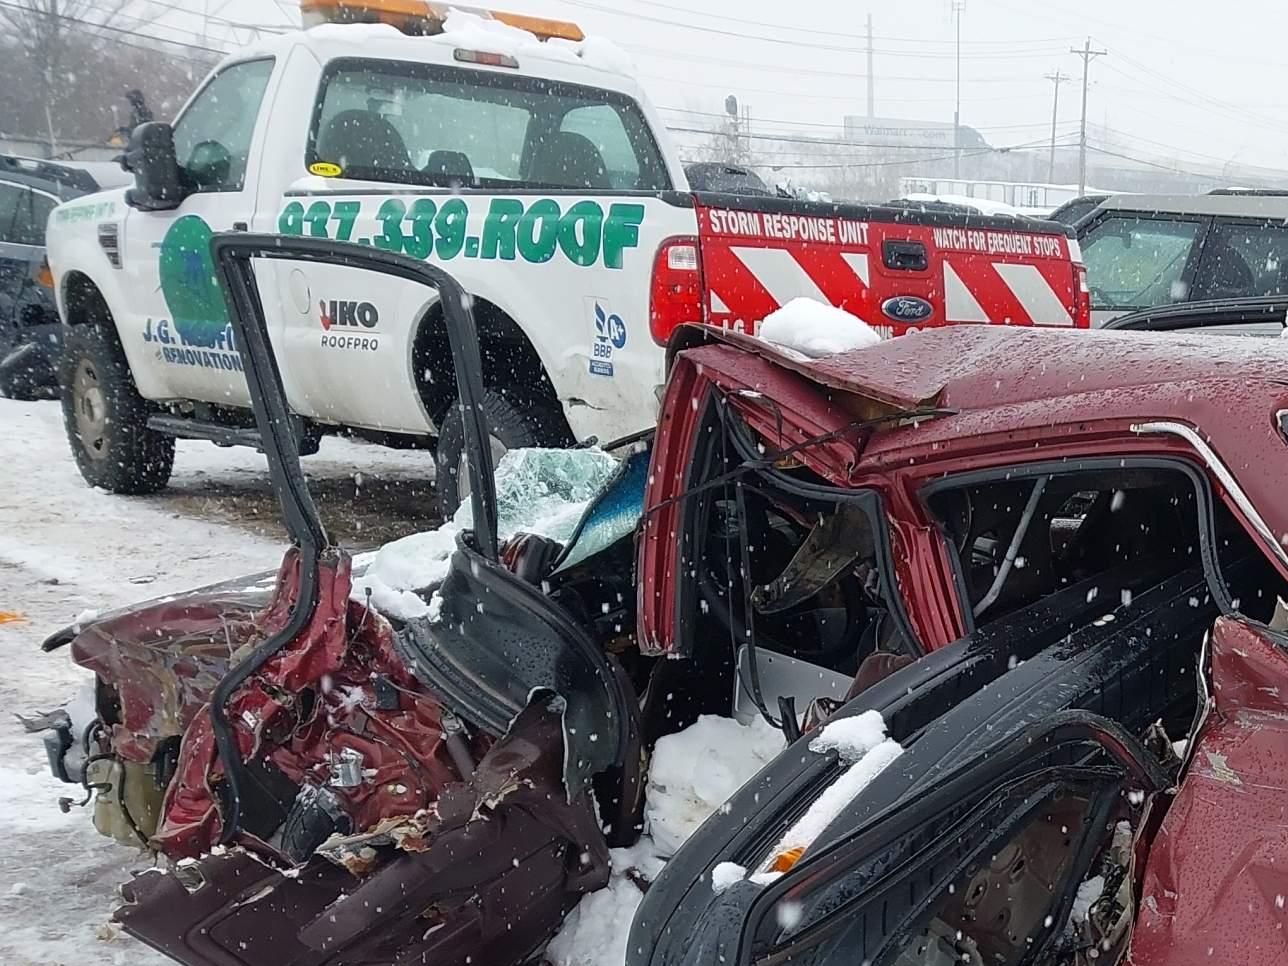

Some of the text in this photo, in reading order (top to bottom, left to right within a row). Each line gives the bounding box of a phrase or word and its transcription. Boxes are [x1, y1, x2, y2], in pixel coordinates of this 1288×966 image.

[278, 198, 645, 269] 937.339.ROOF
[709, 209, 869, 245] STORM RESPONSE UNIT
[933, 228, 966, 249] WATCH
[968, 231, 987, 250] FOR
[1034, 236, 1061, 257] STOPS
[895, 299, 924, 315] Ford
[142, 318, 175, 343] J.G.
[321, 335, 379, 351] ROOFPRO
[593, 343, 612, 358] BBB
